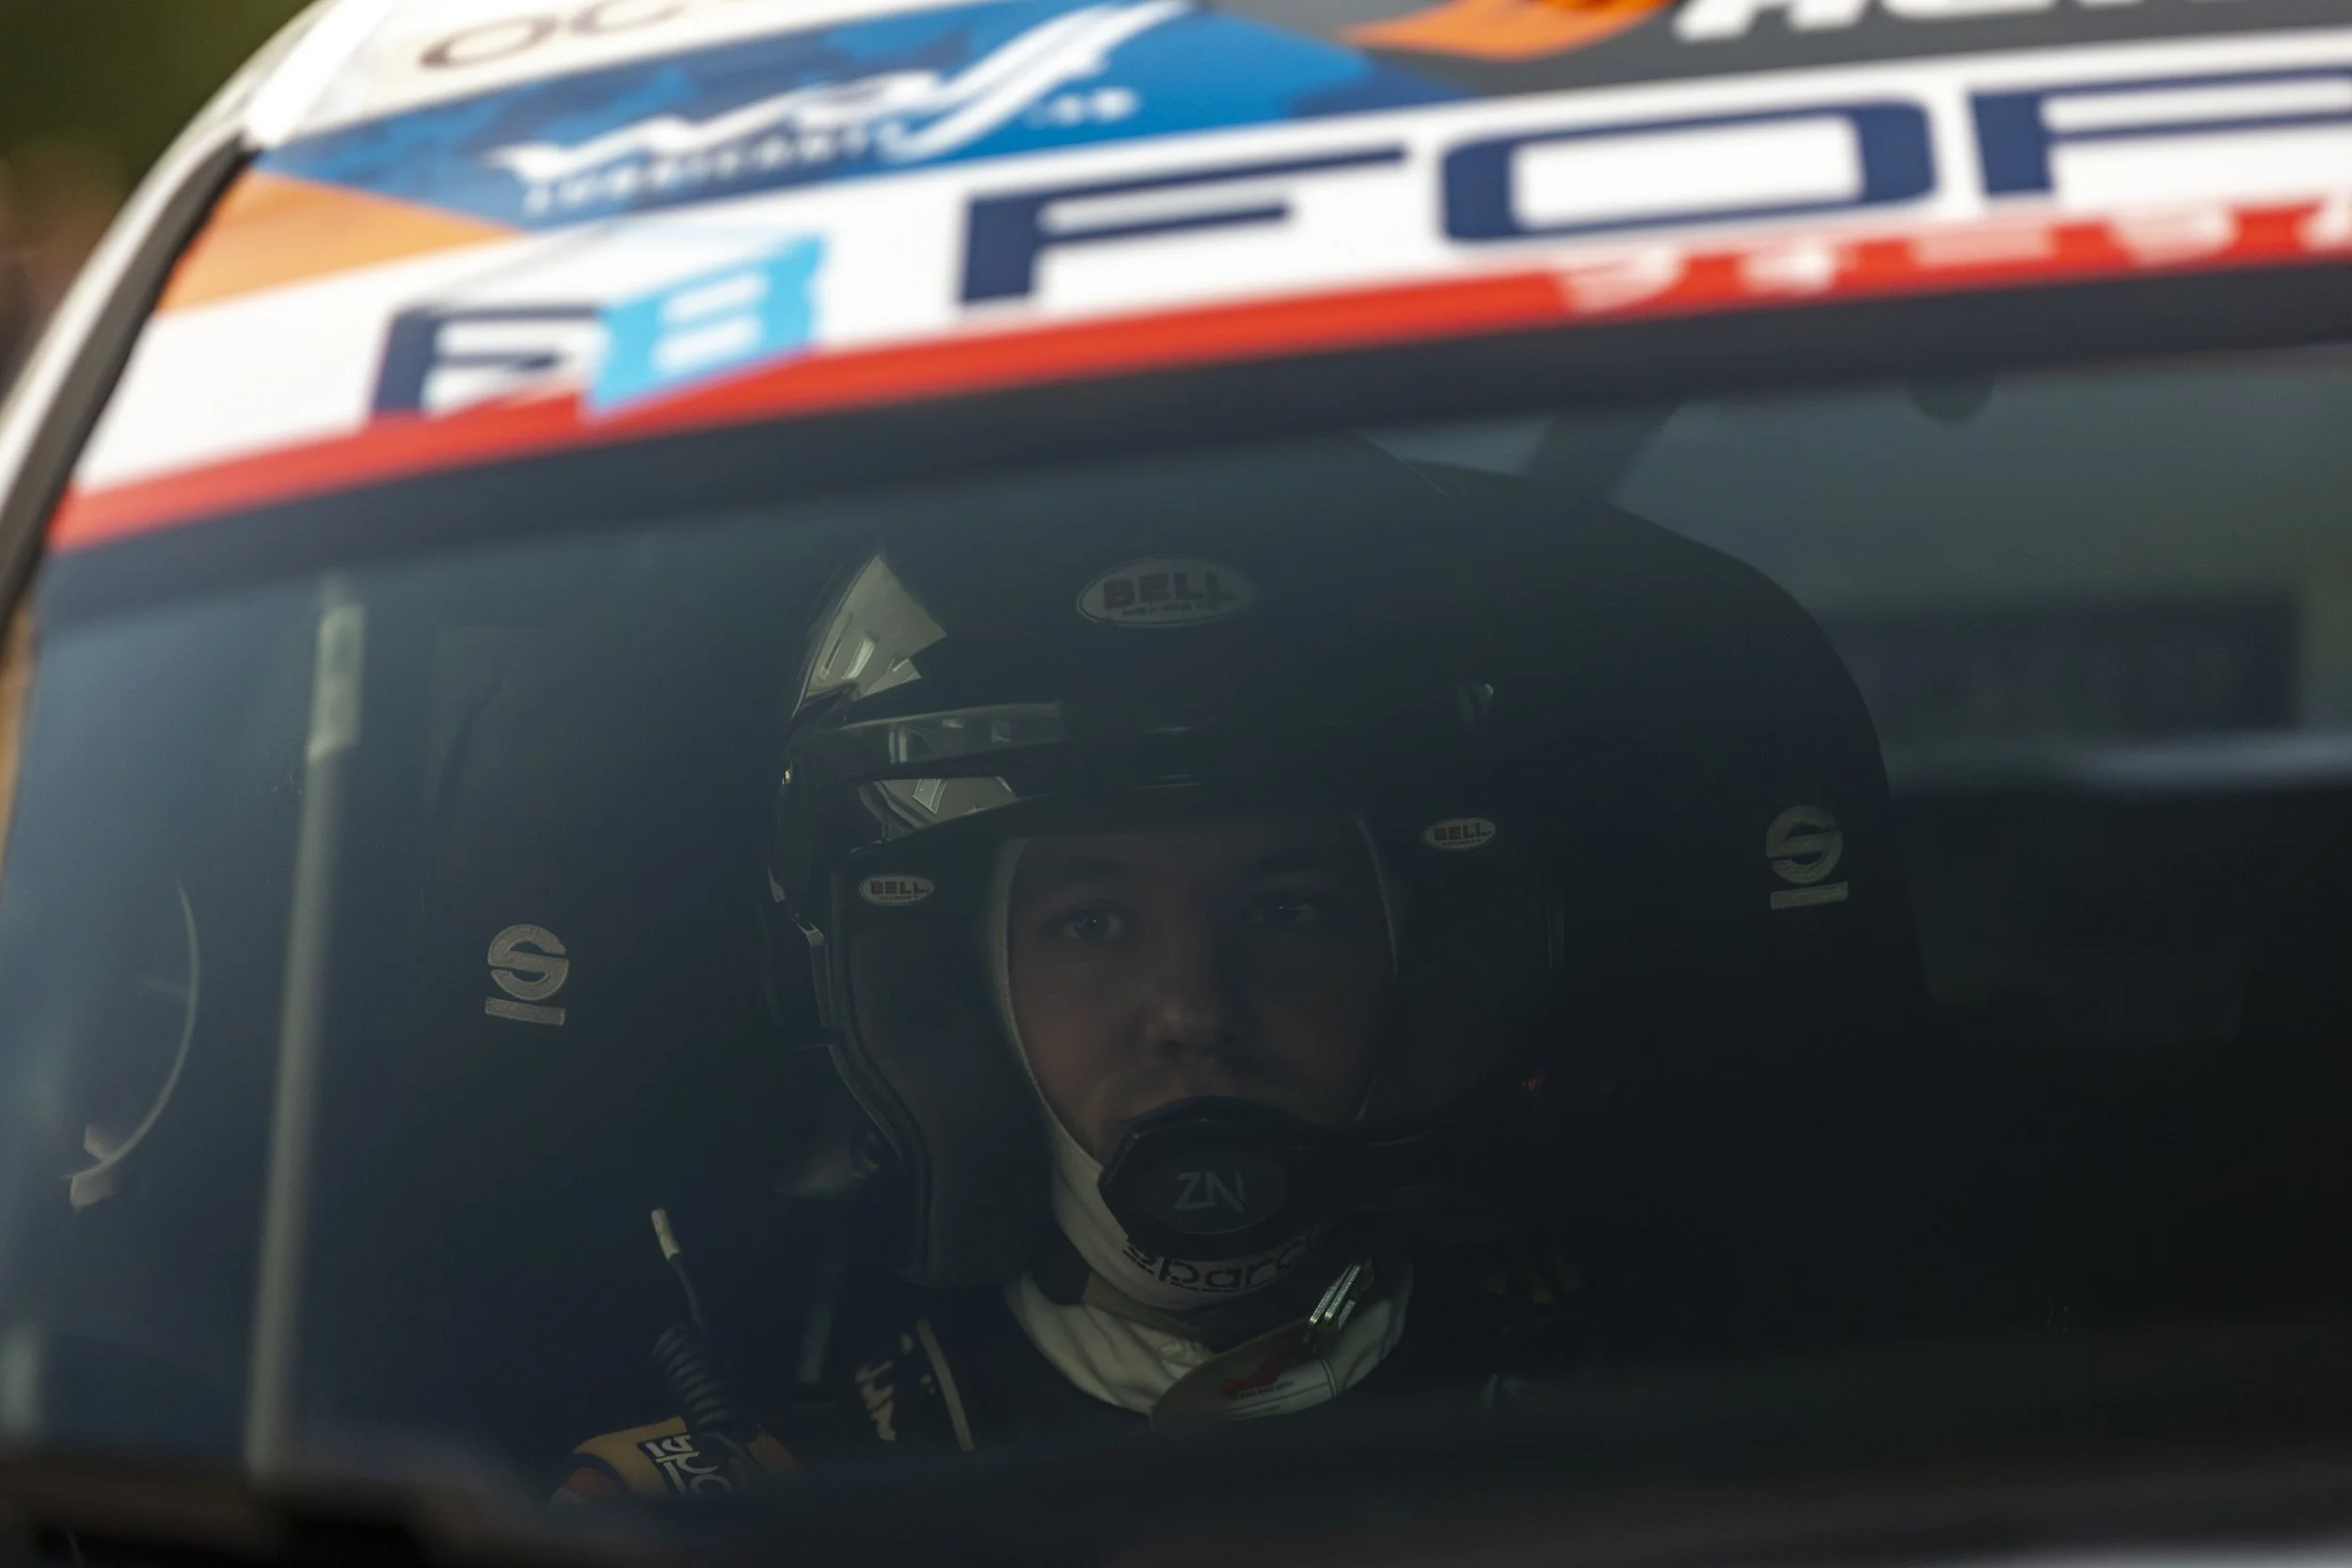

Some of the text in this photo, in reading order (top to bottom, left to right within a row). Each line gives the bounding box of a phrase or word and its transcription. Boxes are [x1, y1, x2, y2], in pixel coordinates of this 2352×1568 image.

[1103, 569, 1243, 610] BELL
[1433, 821, 1493, 841] BELL
[870, 880, 931, 895] BELL
